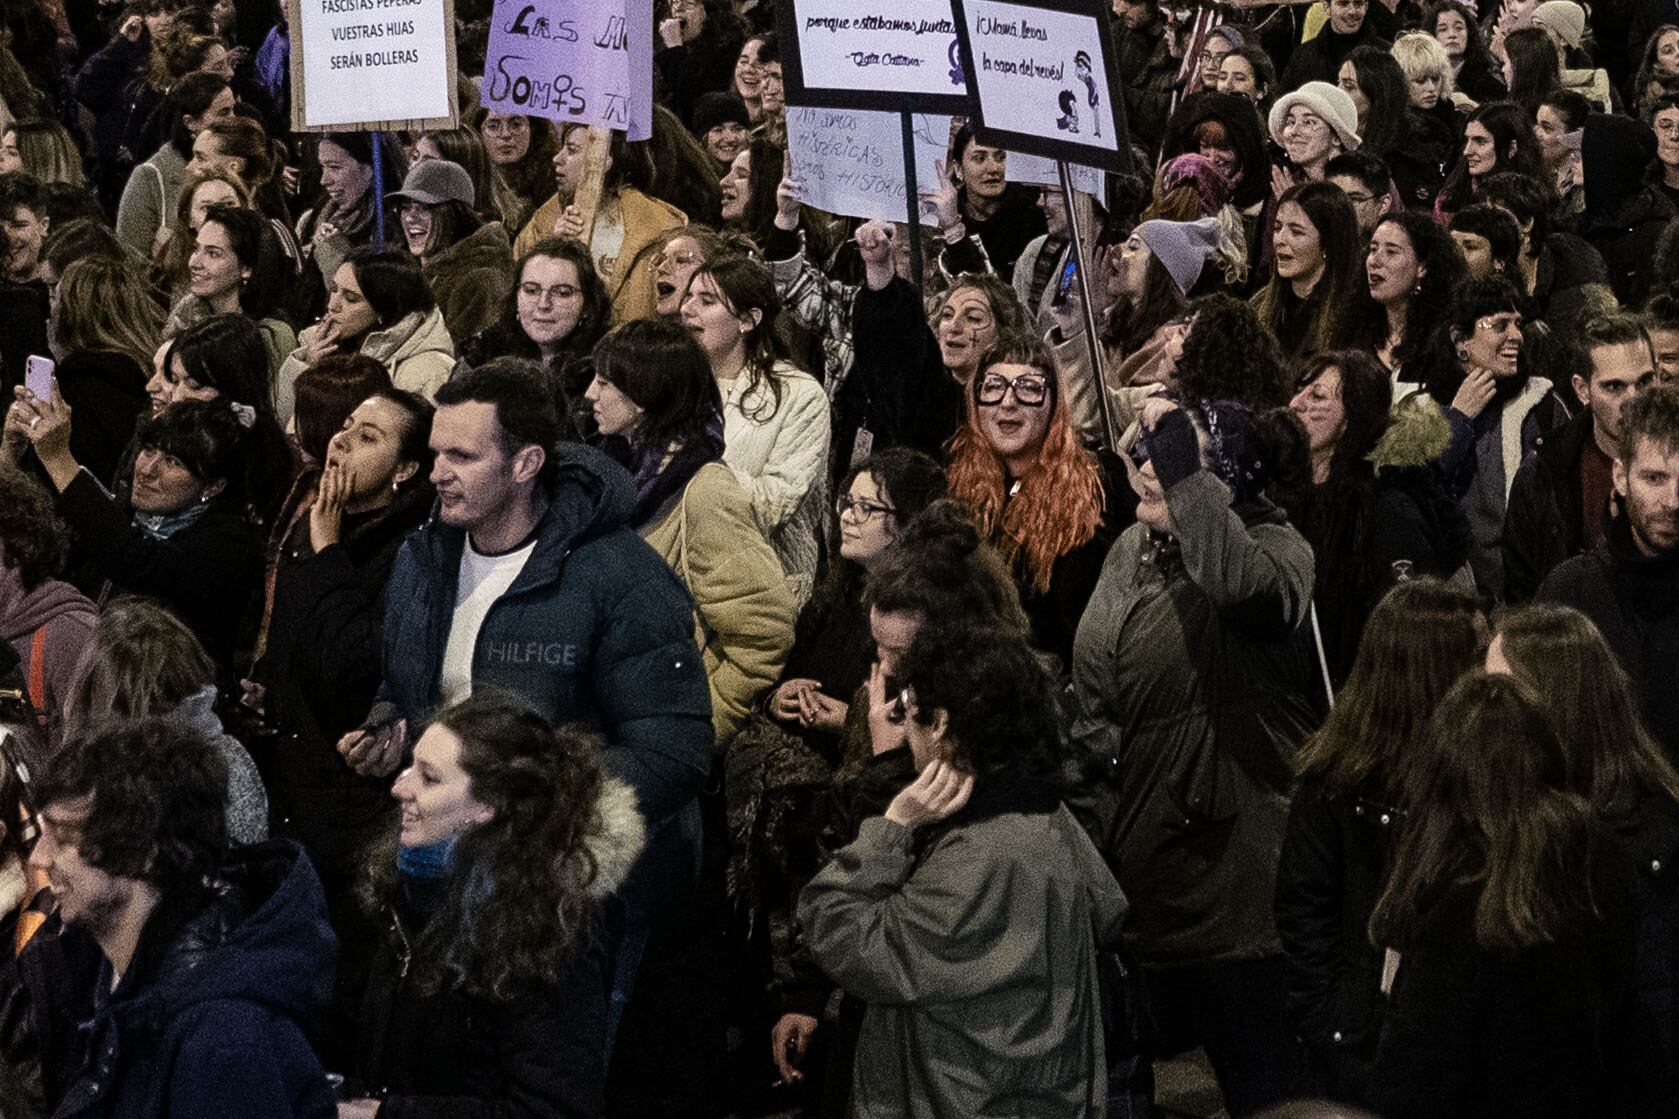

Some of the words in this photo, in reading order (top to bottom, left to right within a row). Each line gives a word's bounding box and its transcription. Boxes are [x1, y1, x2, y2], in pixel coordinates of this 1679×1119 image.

[331, 23, 384, 41] VUESTRAS
[387, 20, 415, 36] HIJAS
[806, 16, 851, 33] porque
[330, 50, 363, 70] SERÁN
[365, 49, 419, 67] BOLLERAS
[982, 51, 992, 71] la
[994, 59, 1017, 76] capa
[1019, 58, 1034, 78] del
